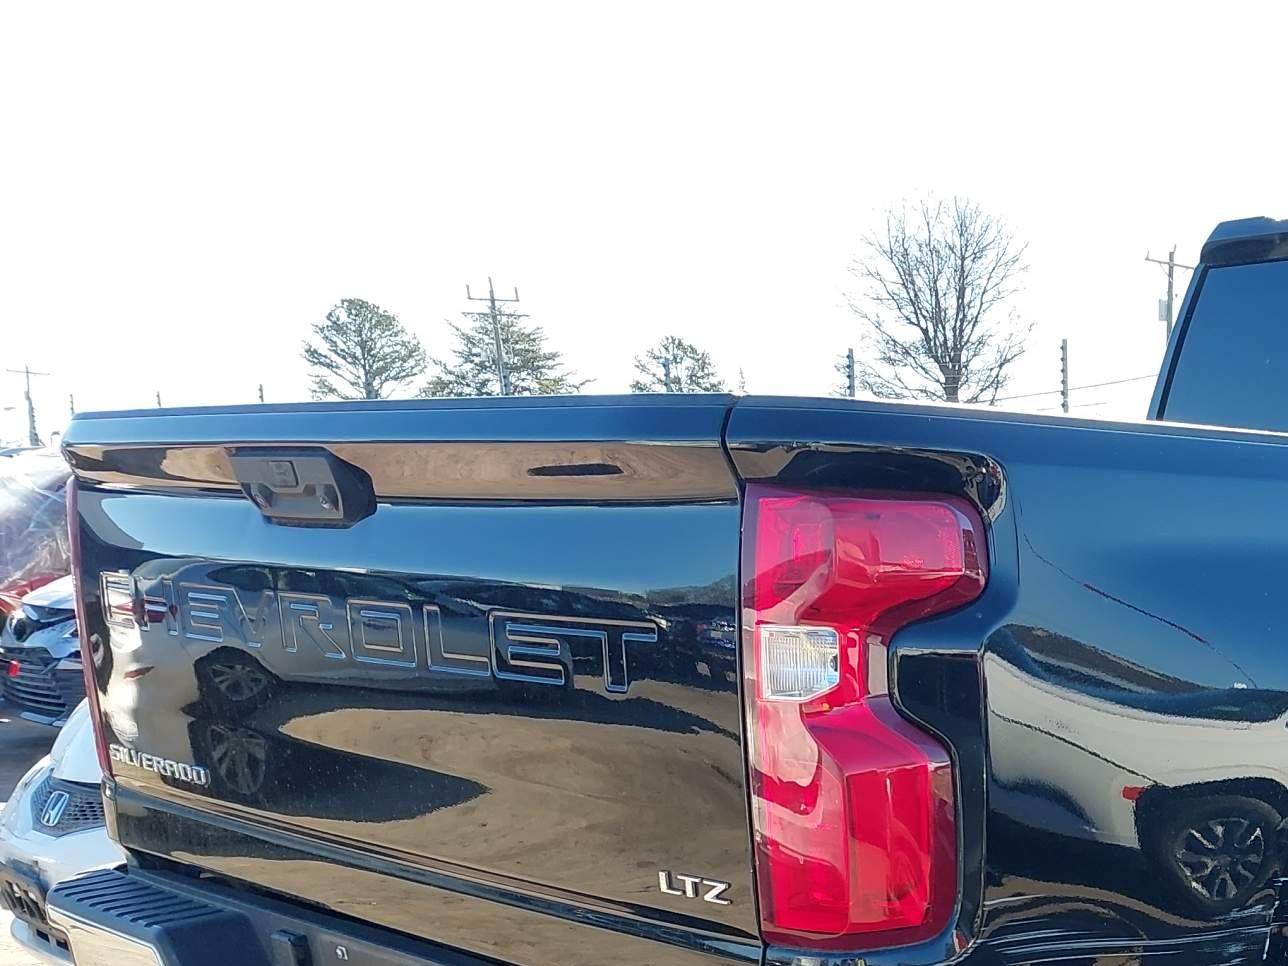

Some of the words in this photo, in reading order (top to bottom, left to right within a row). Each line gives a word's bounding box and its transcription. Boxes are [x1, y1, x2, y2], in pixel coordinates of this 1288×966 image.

[100, 571, 658, 693] CHEVROLET
[109, 744, 211, 788] SILVERADO
[658, 870, 733, 905] LTZ
